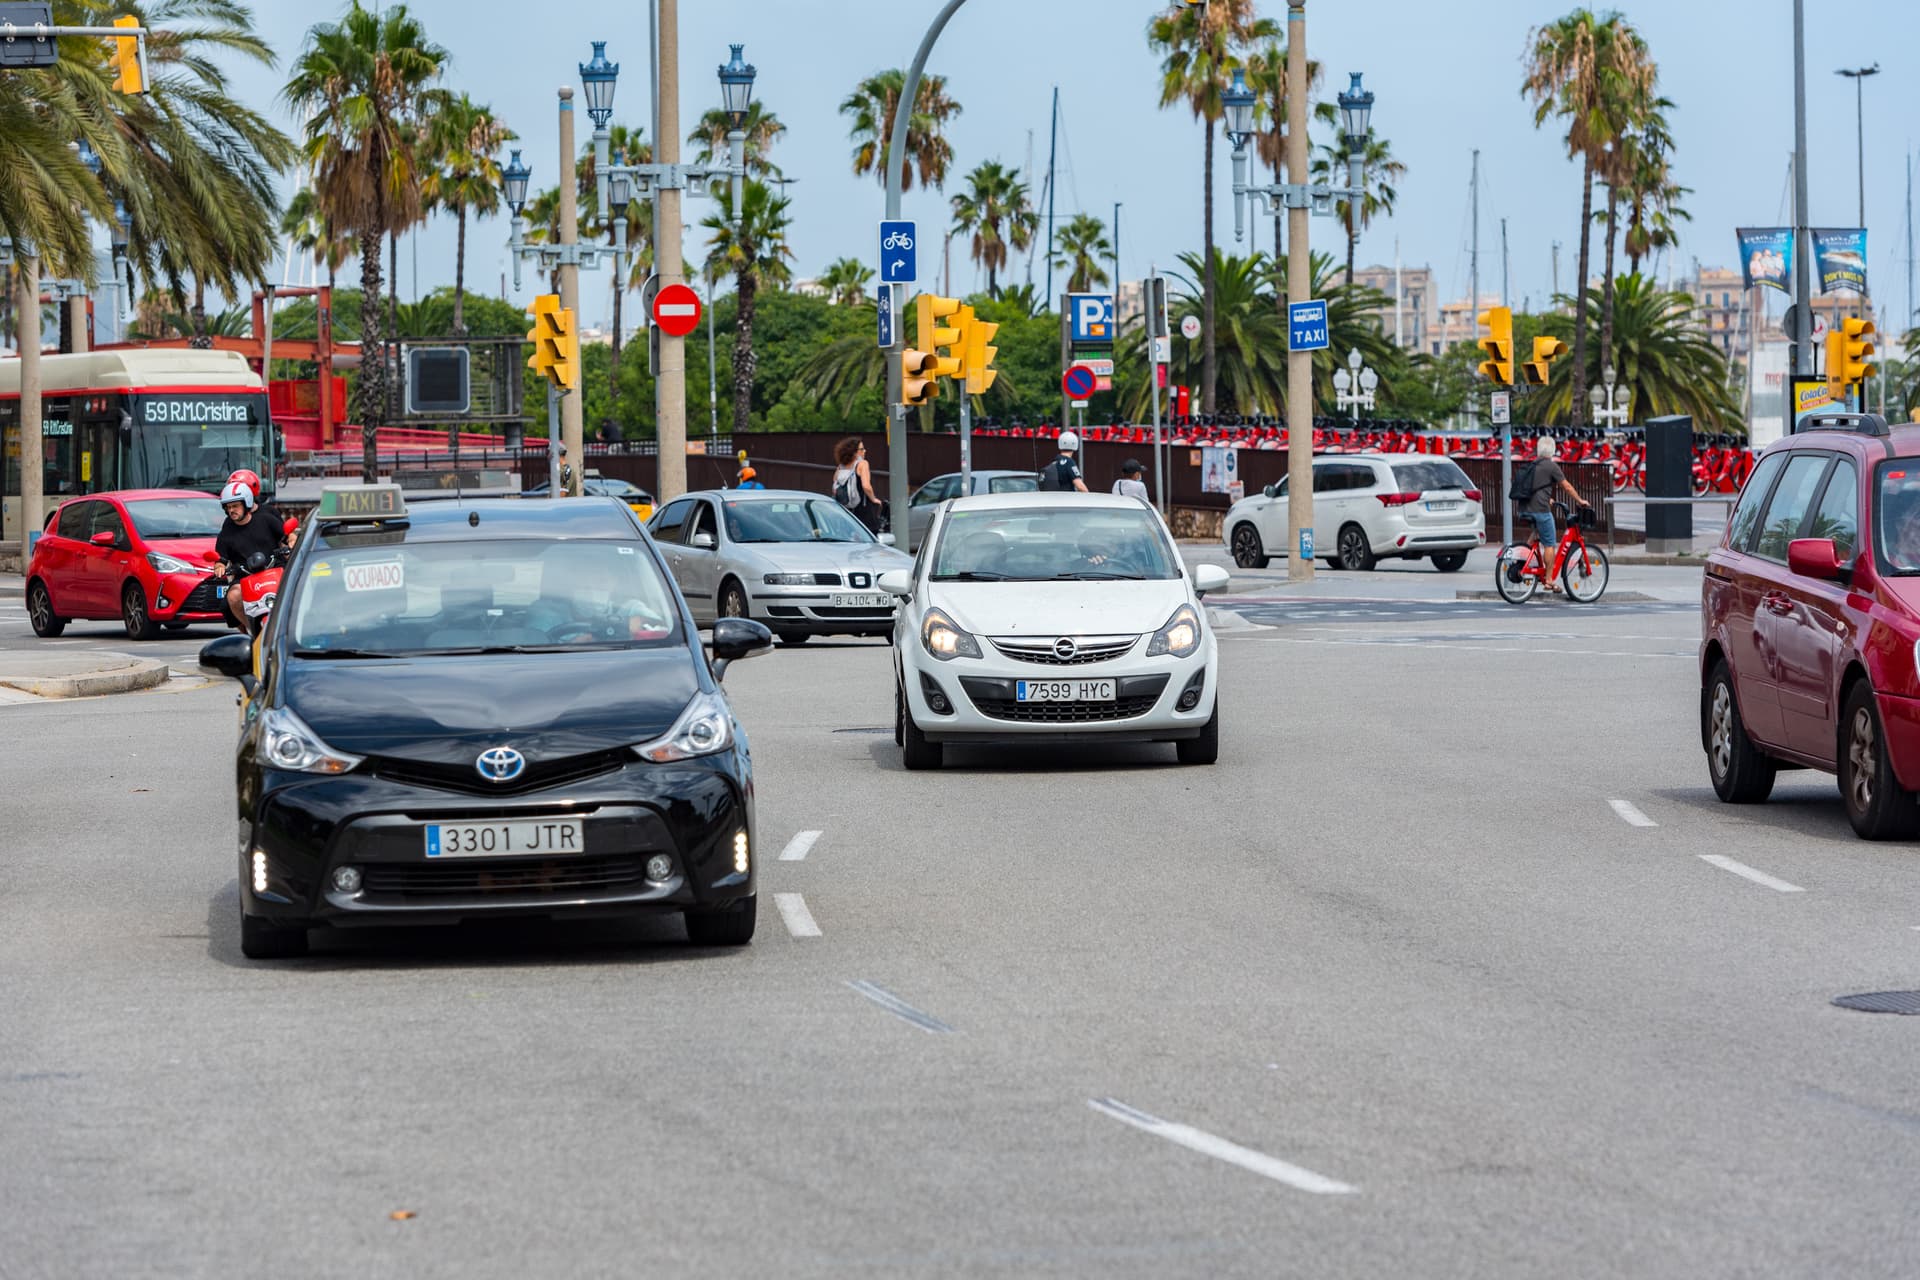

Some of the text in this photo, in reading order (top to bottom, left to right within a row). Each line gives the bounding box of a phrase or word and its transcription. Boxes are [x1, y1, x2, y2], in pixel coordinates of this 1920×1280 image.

[1079, 299, 1105, 336] P
[1293, 329, 1325, 344] TAXI
[145, 401, 248, 422] 59 R.M.Cristina
[340, 491, 376, 513] TAXI
[347, 564, 401, 590] OCUPADO
[1029, 682, 1110, 700] 7599 HYC
[446, 824, 576, 853] 3301 JTR
